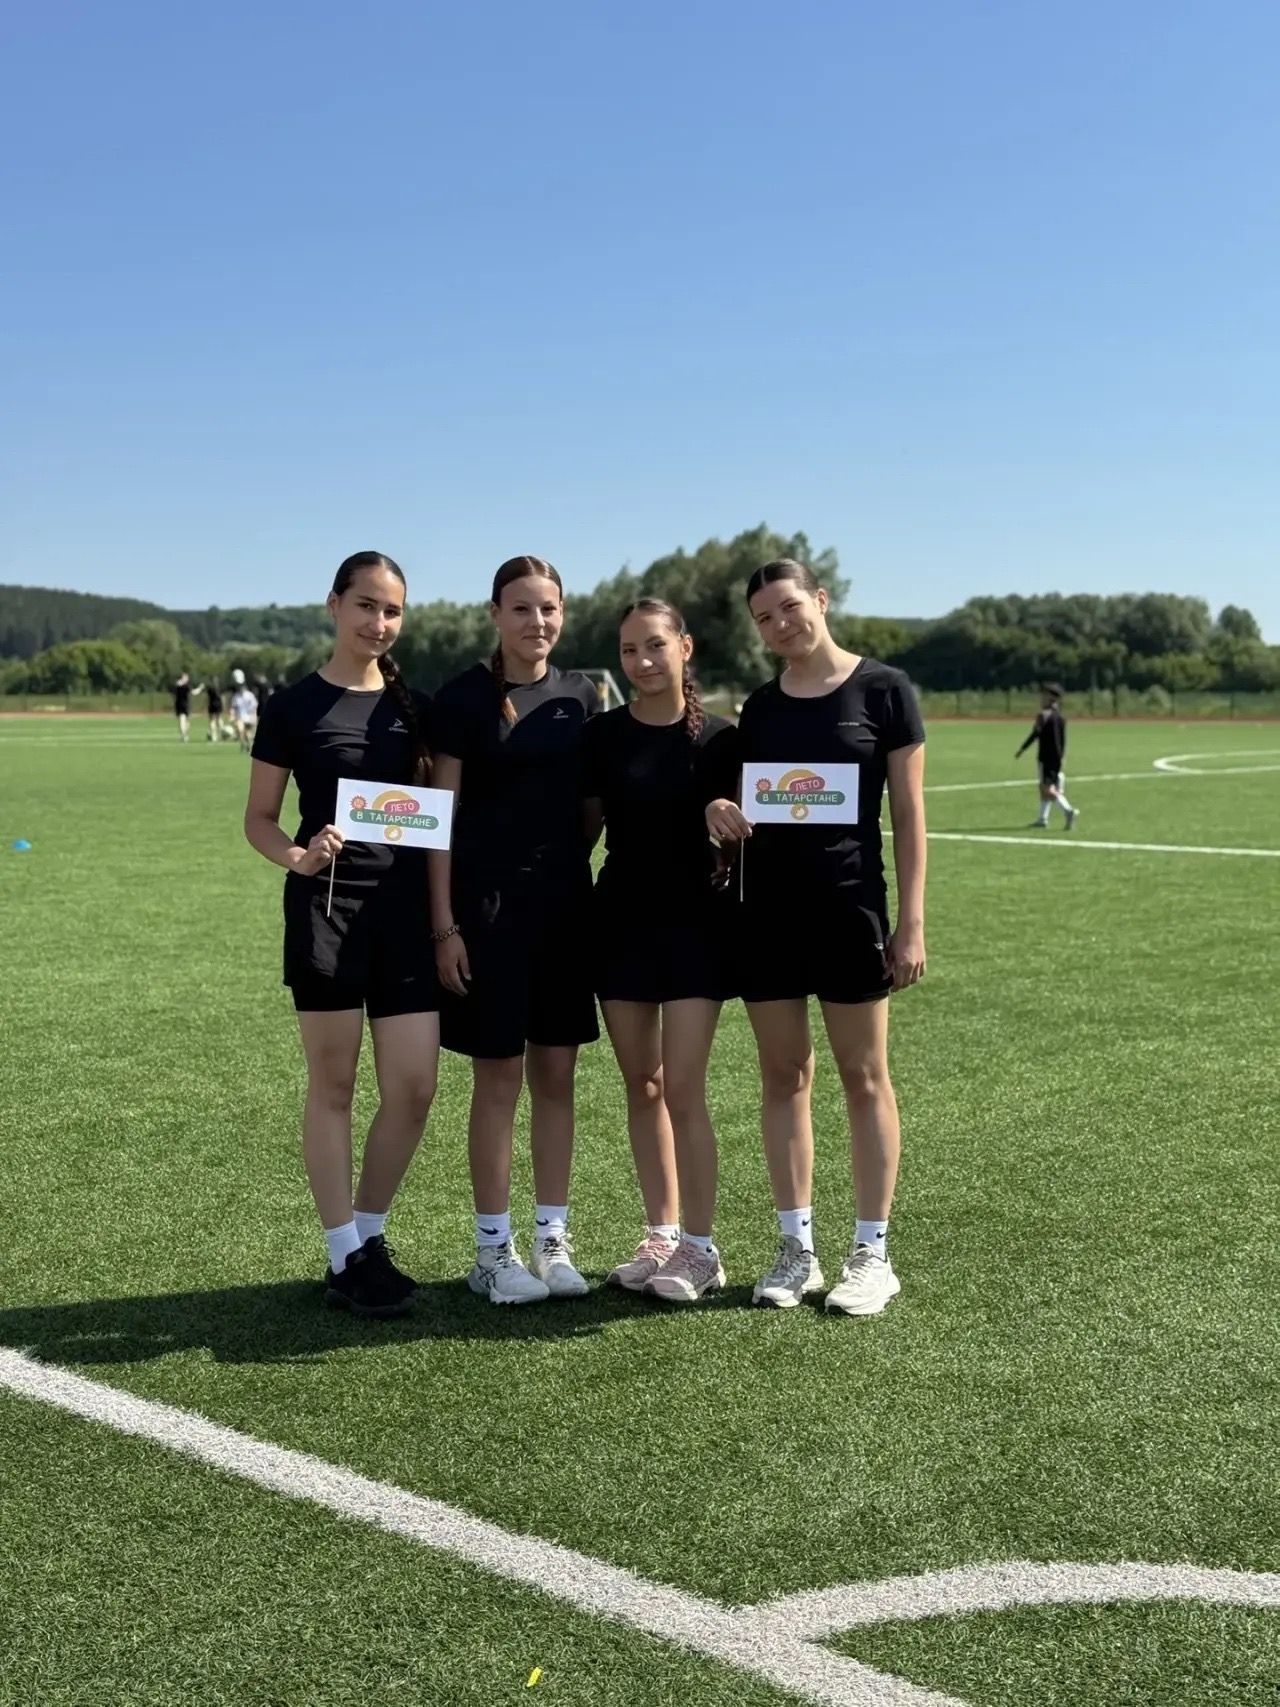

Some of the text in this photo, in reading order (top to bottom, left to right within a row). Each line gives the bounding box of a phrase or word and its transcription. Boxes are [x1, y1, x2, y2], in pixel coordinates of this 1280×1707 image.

[795, 779, 820, 792] ЛЕТО
[762, 793, 838, 803] В ТАТАРСТАНЕ
[390, 802, 415, 812] ЛЕТО
[356, 812, 432, 827] В ТАТАРСТАНЕ
